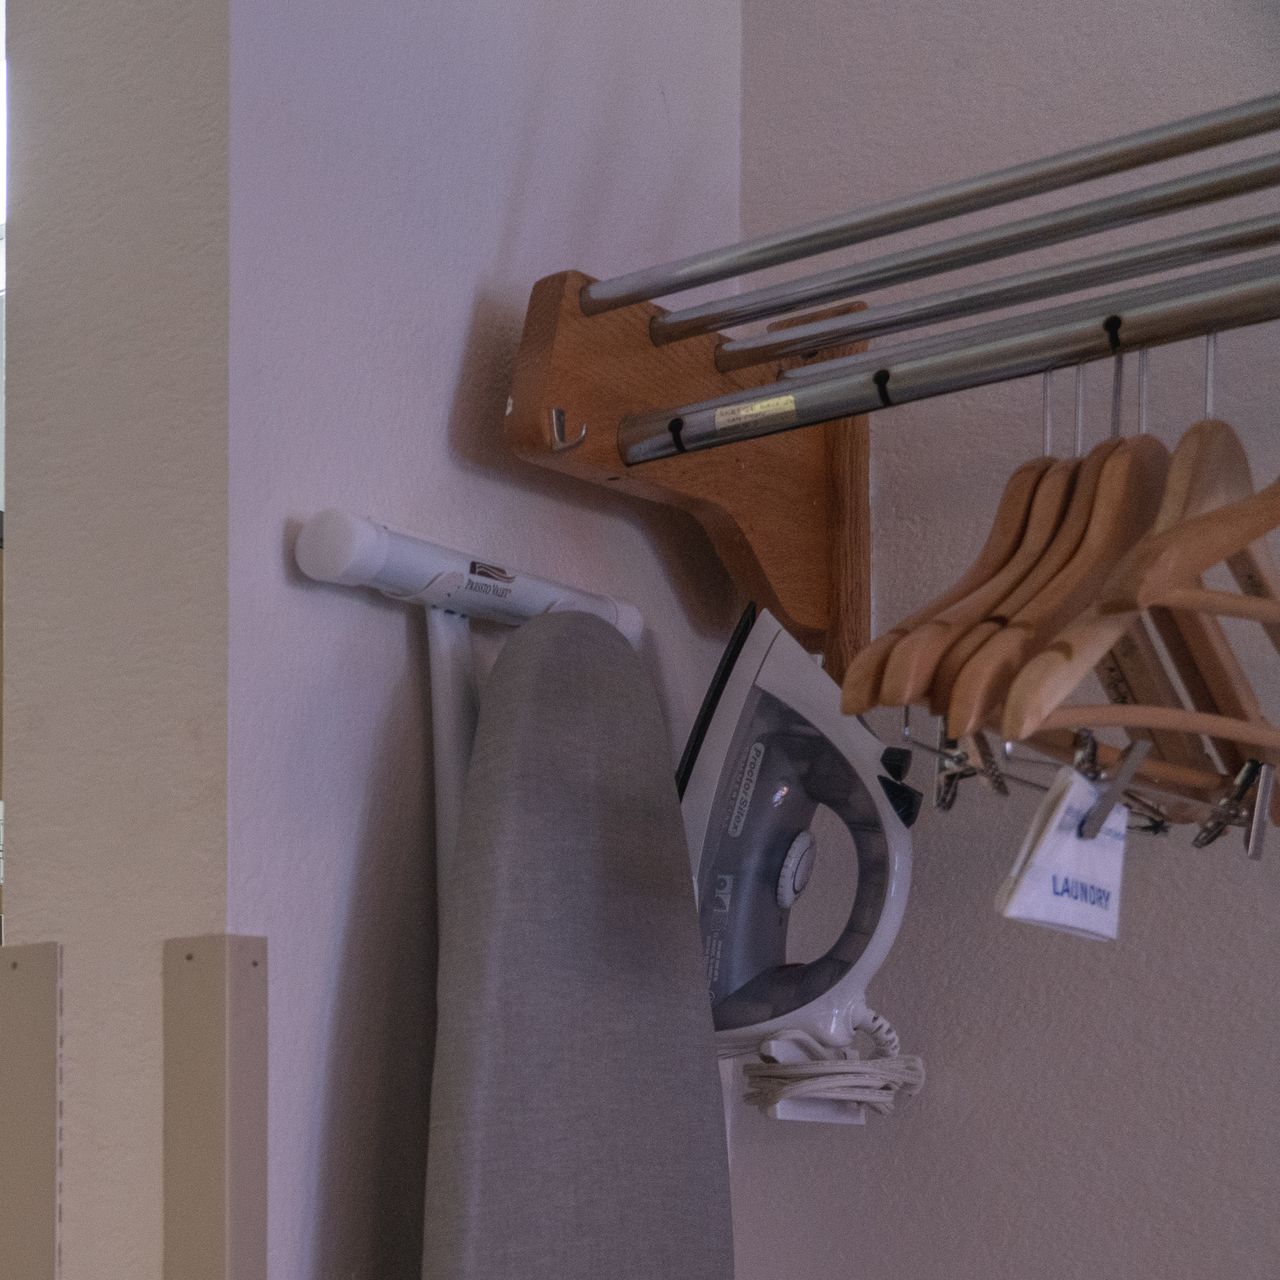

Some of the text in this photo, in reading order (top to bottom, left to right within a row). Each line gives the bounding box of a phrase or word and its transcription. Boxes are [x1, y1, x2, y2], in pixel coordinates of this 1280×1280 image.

[733, 747, 761, 830] Proctor Silex
[1052, 874, 1111, 911] LAUNDRY
